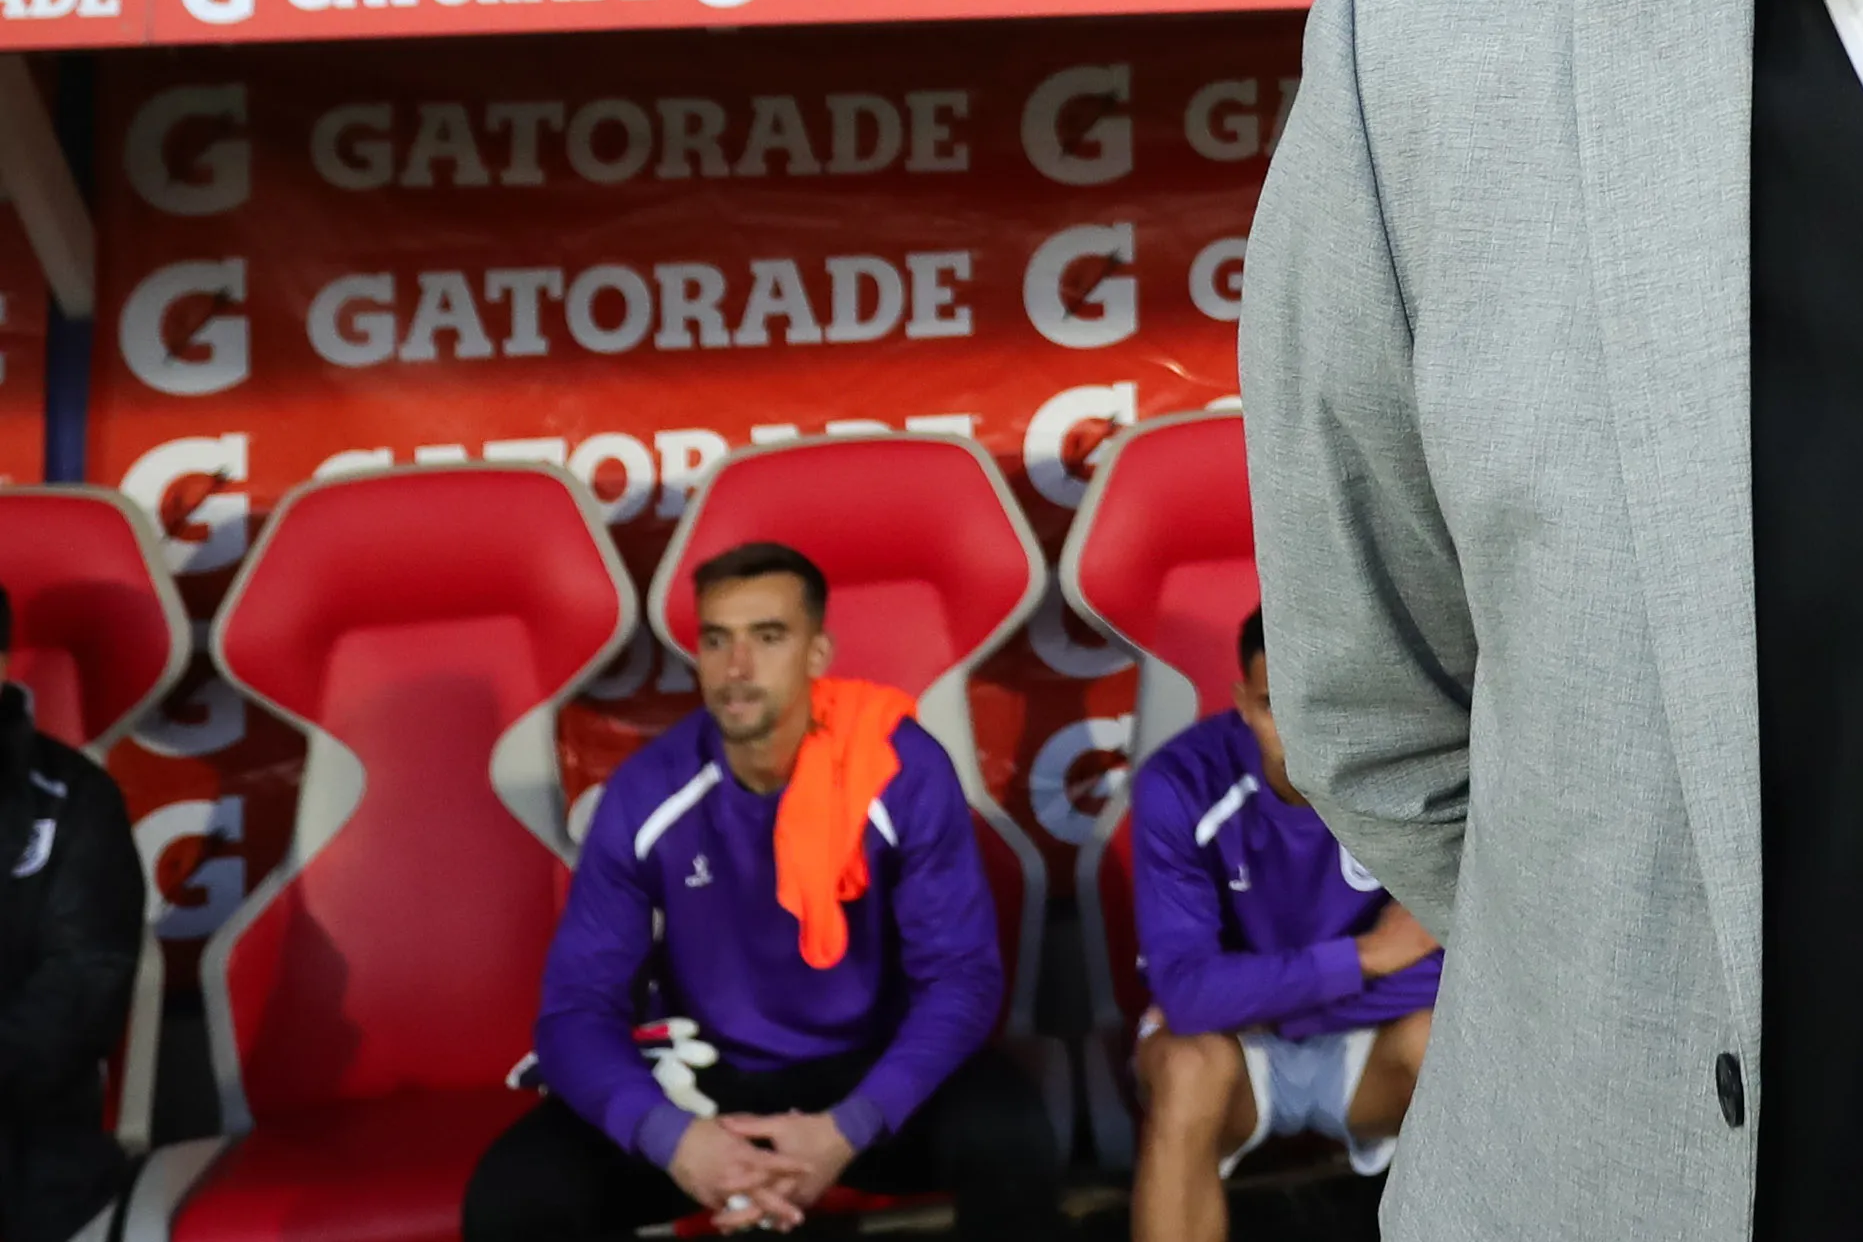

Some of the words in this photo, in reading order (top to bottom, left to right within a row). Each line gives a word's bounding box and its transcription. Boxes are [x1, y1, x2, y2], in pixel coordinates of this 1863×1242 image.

[126, 84, 250, 216] G
[311, 91, 969, 189] GATORADE
[1021, 64, 1133, 185] G
[119, 257, 250, 395] G
[307, 251, 973, 369] GATORADE
[1022, 222, 1138, 349] G
[119, 432, 250, 575] G
[131, 795, 247, 939] G
